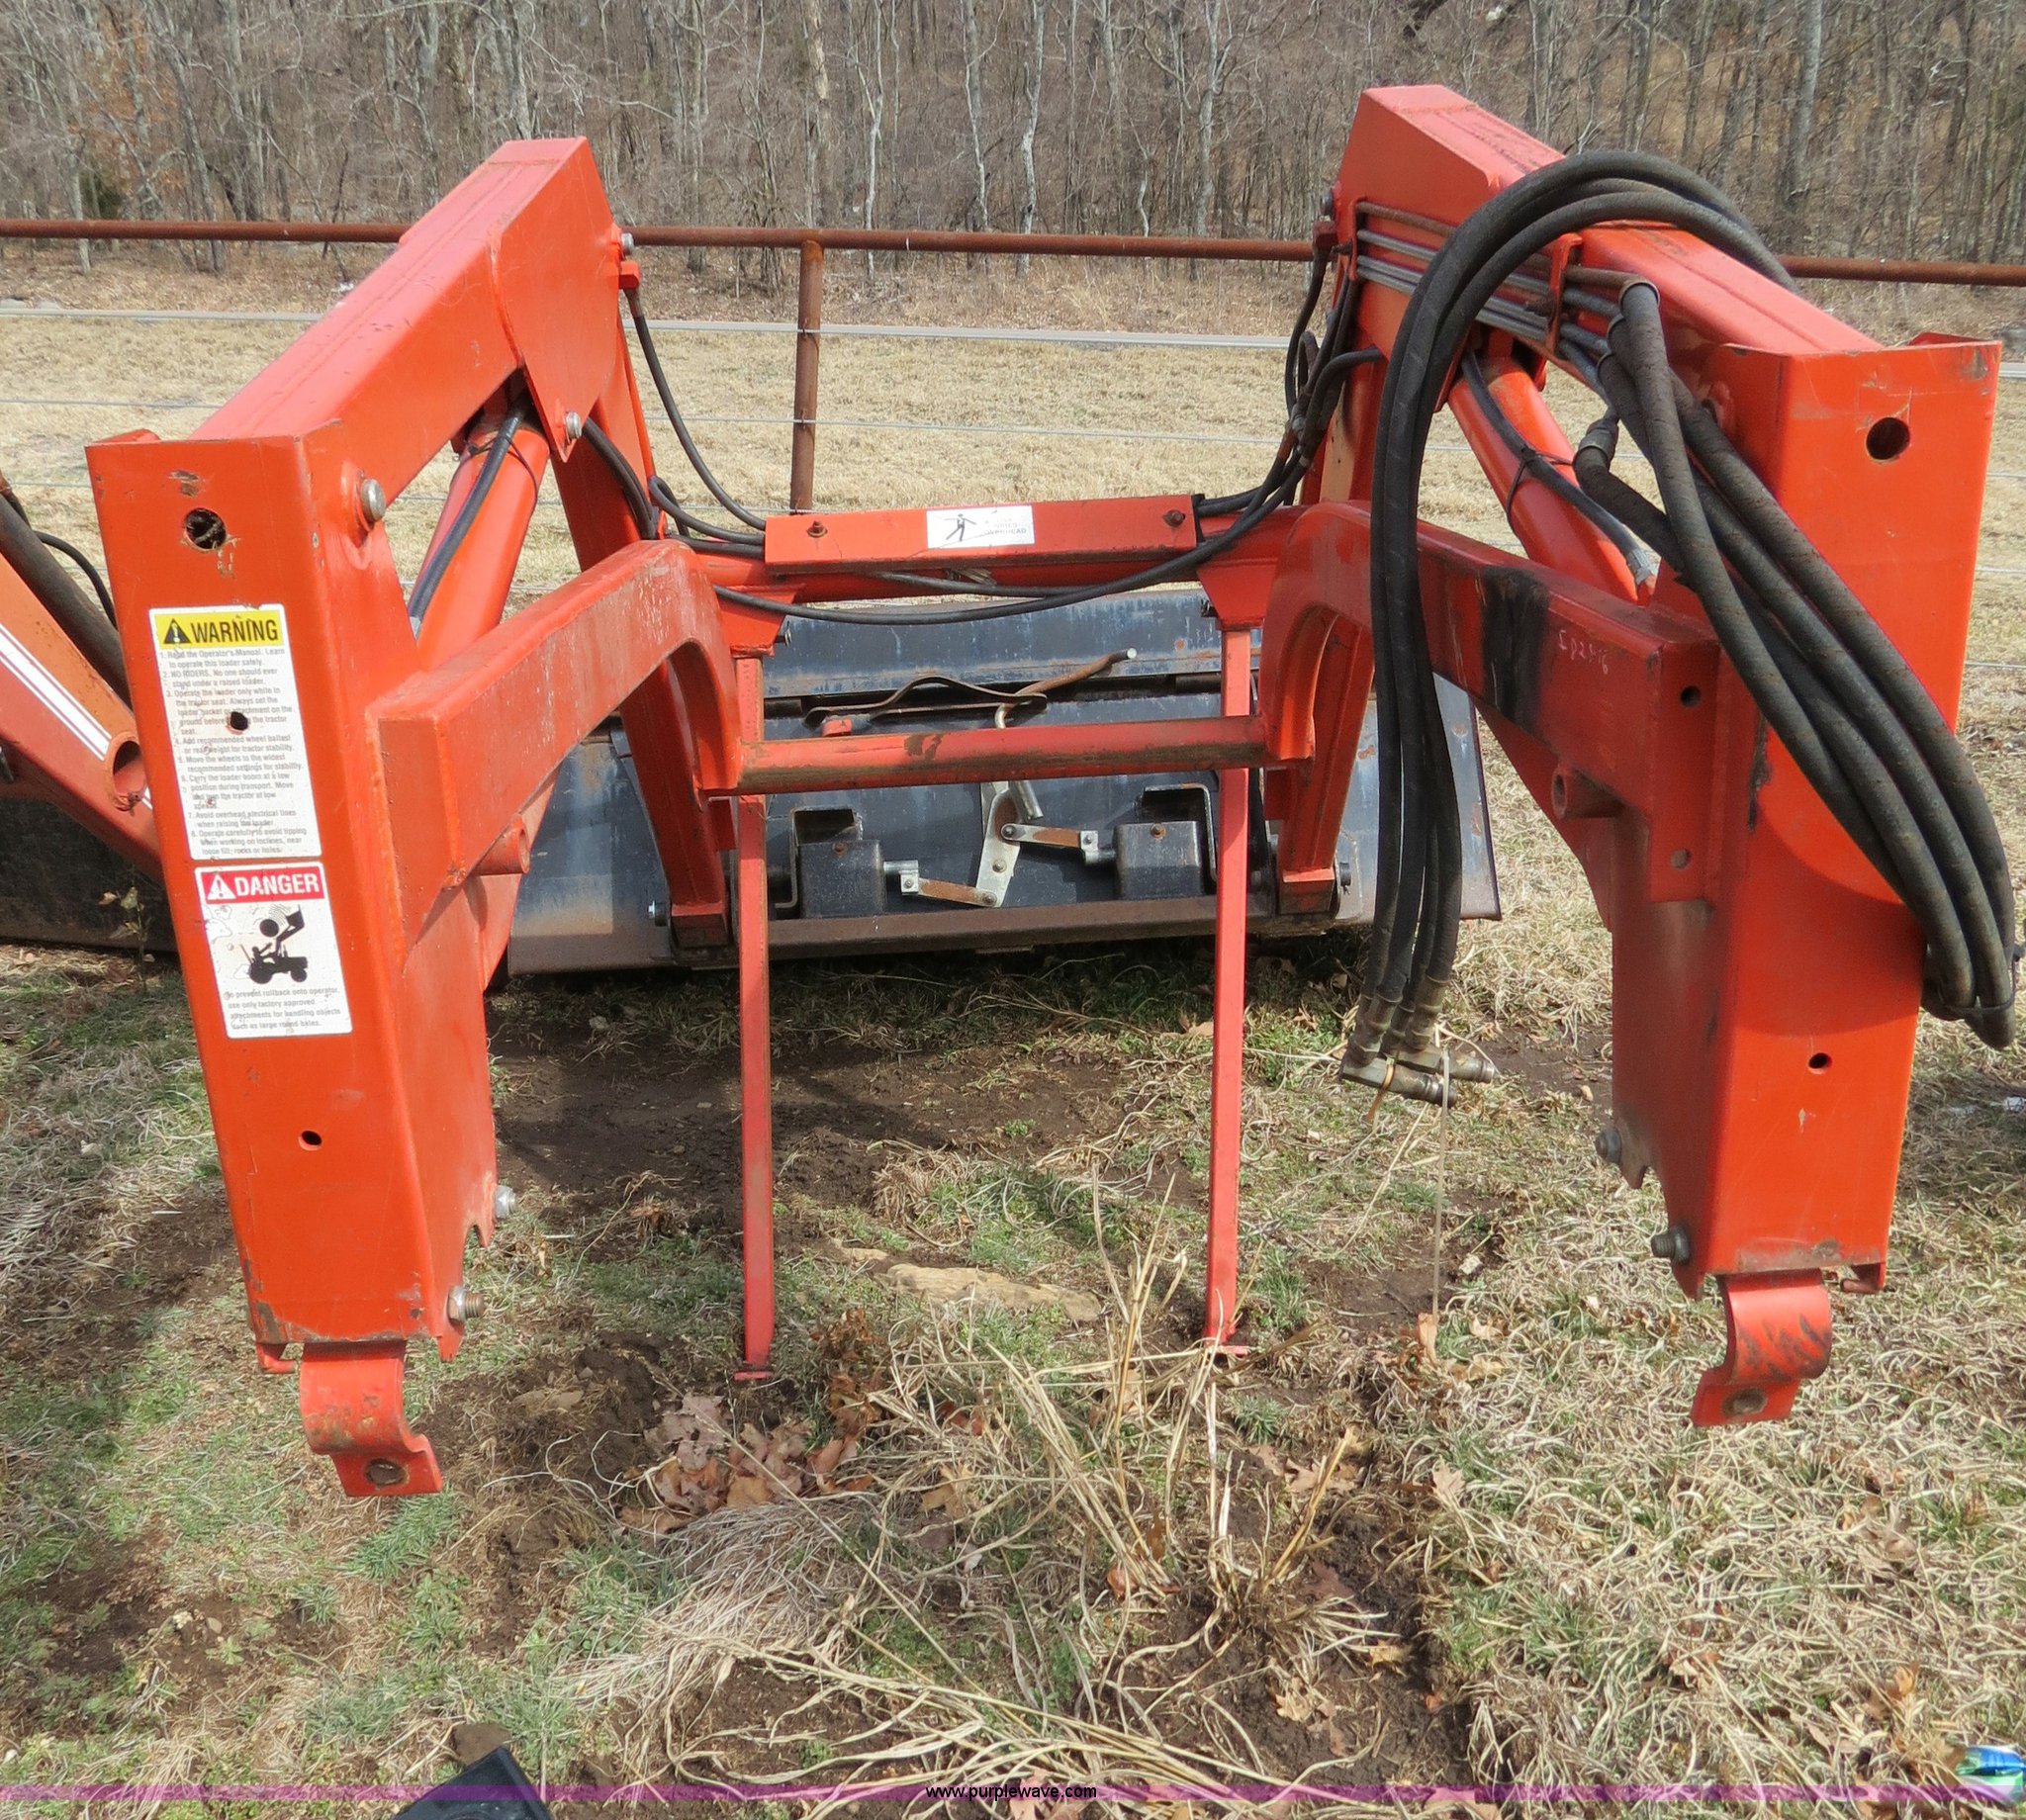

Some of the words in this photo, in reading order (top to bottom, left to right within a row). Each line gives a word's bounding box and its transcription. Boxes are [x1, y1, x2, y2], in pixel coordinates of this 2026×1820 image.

[191, 619, 278, 643] WARNING
[178, 661, 203, 670] operate
[266, 743, 294, 752] stability.
[189, 774, 207, 783] Carry
[219, 782, 239, 791] during
[241, 781, 273, 790] transport.
[217, 819, 238, 828] raising
[220, 837, 245, 846] working
[234, 873, 319, 896] DANGER
